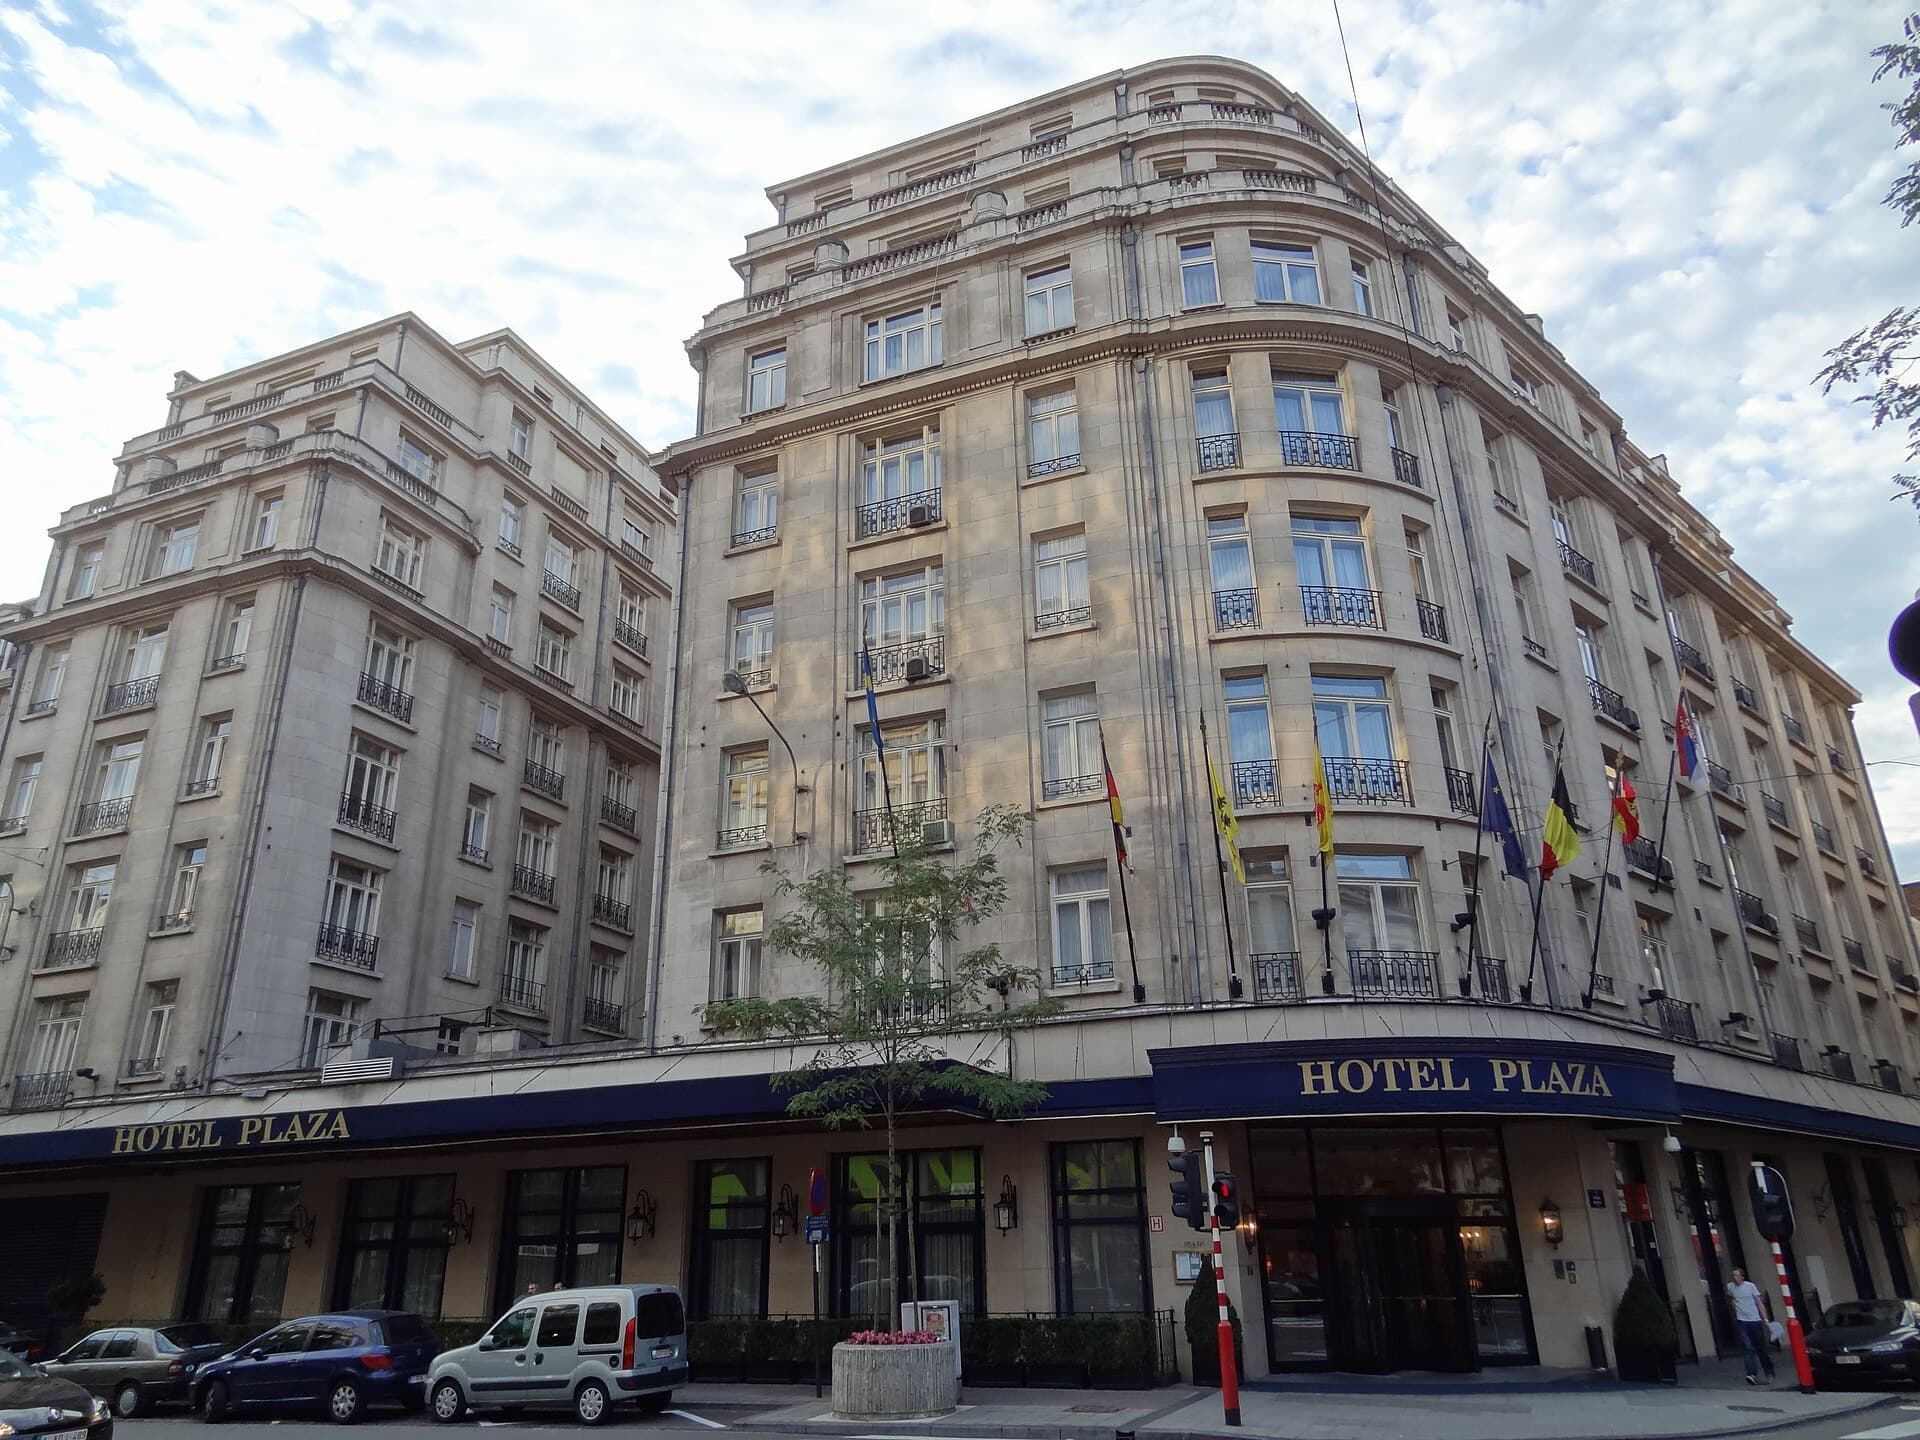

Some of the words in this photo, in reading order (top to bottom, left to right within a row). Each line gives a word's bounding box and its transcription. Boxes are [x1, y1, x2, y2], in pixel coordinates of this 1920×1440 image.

[1297, 1058, 1470, 1095] HOTEL
[1488, 1058, 1613, 1097] PLAZA
[112, 1121, 221, 1154] HOTEL
[237, 1112, 350, 1146] PLAZA
